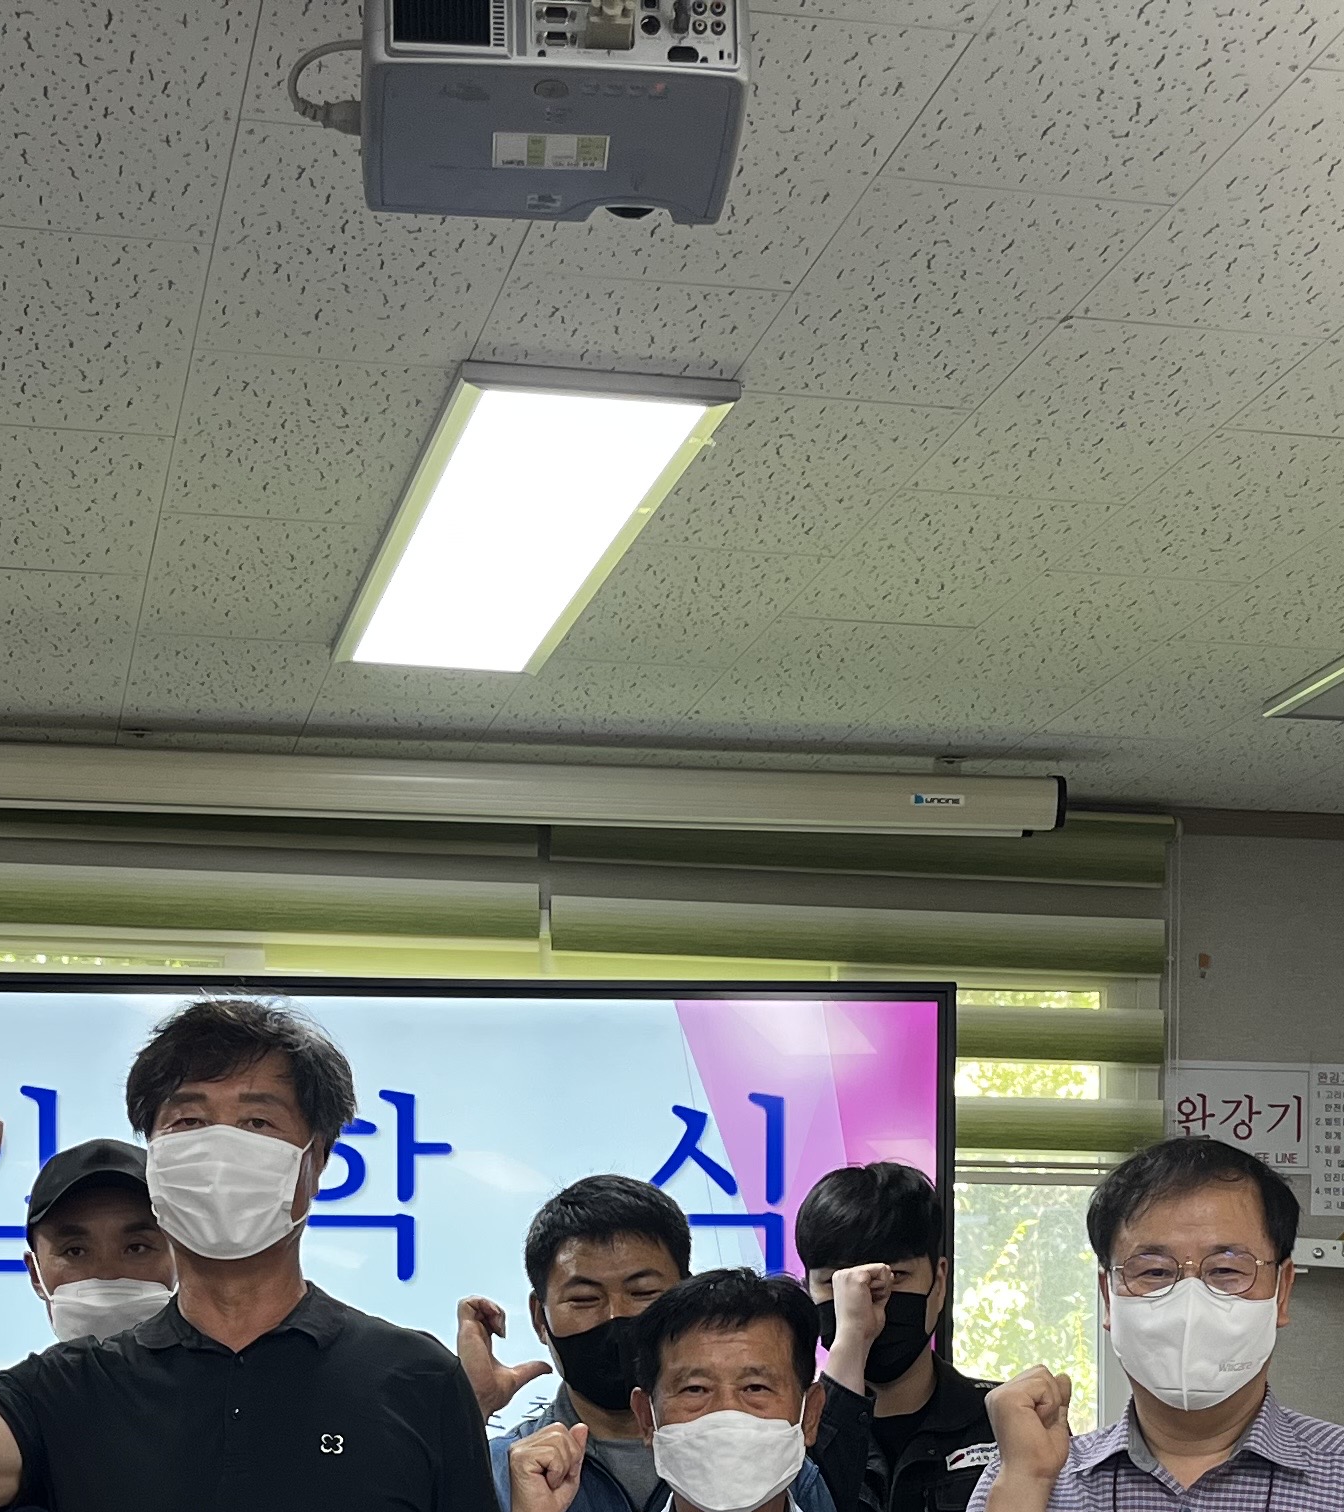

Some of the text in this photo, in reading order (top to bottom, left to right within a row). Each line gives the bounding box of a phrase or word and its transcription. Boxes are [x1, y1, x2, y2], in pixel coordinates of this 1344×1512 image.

[1174, 1093, 1303, 1143] 완강기
[1275, 1152, 1298, 1164] LINE
[648, 1092, 785, 1276] 식
